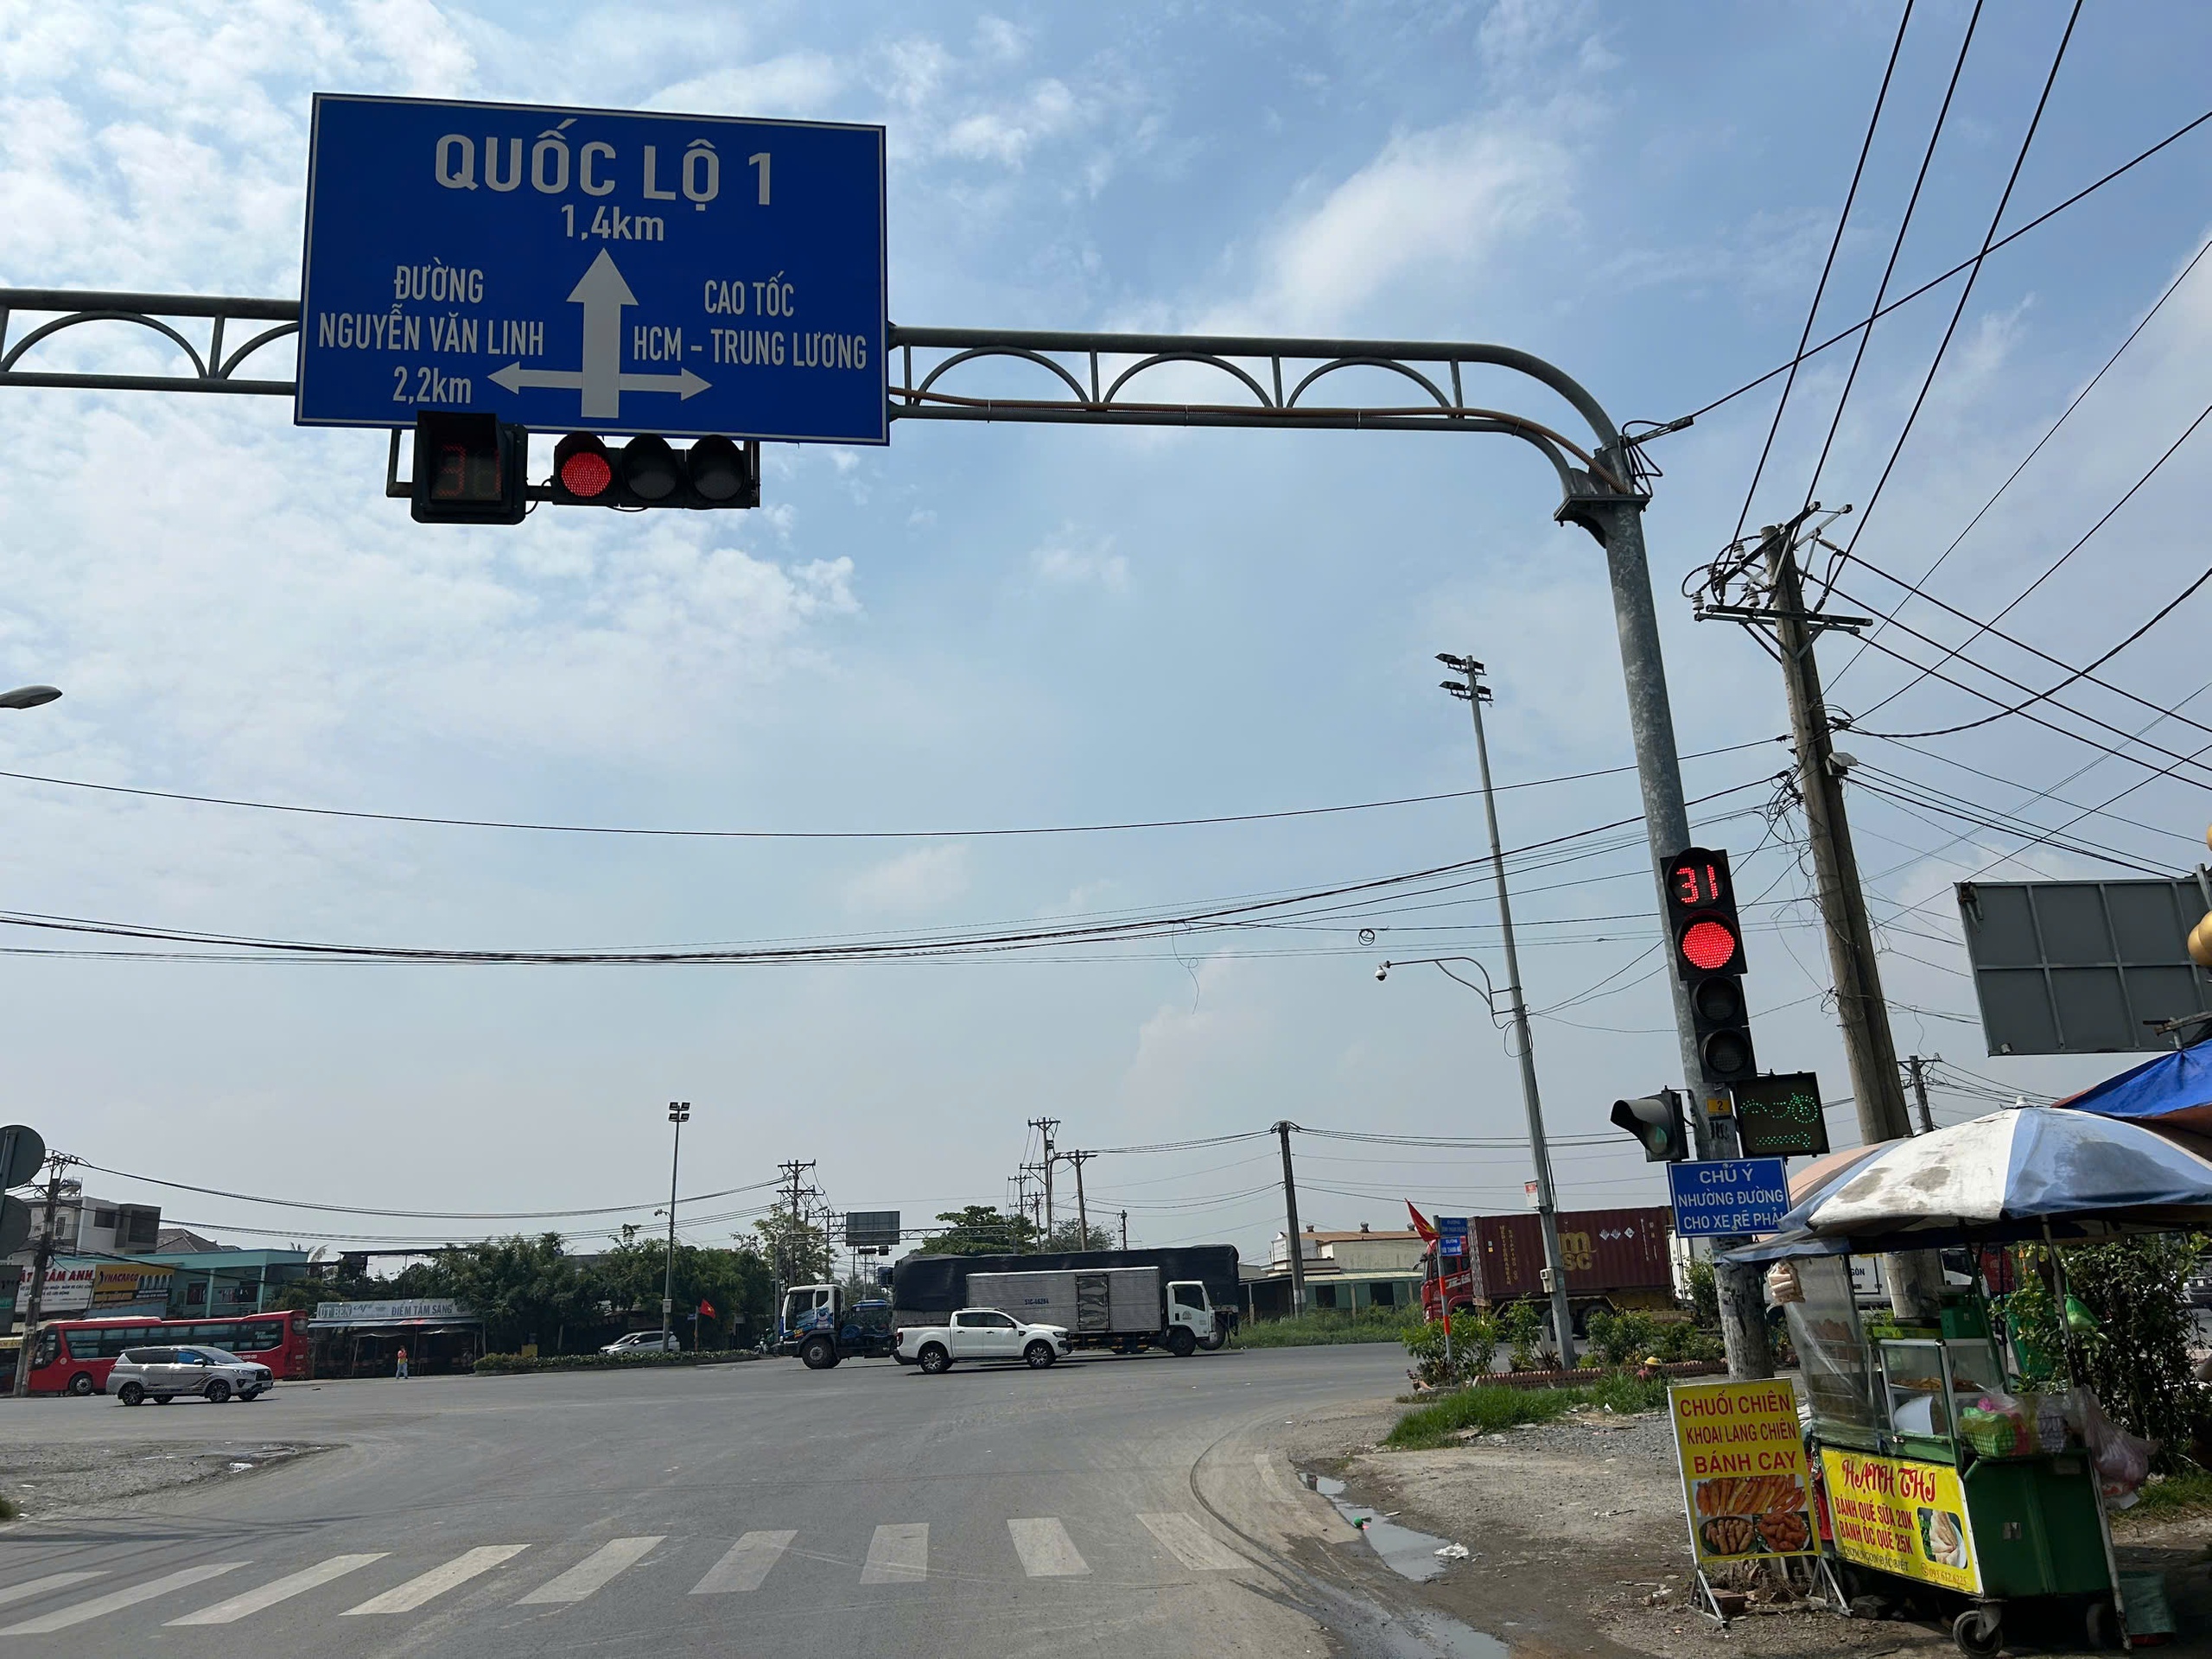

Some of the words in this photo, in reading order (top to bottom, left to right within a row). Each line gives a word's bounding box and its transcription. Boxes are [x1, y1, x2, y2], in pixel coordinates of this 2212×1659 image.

[435, 118, 616, 195] QUỐC
[643, 139, 719, 211] LỘ
[748, 153, 772, 205] 1
[561, 205, 664, 241] 1,4km
[393, 257, 484, 303] ĐƯỜNG
[704, 279, 745, 315] CAO
[752, 270, 794, 317] TỐC
[319, 304, 421, 351] NGUYỄN
[429, 315, 480, 354] VĂN
[487, 321, 544, 356] LINH
[633, 325, 682, 362] HCM
[710, 327, 785, 366] TRUNG
[791, 331, 868, 370] LƯƠNG
[392, 366, 473, 405] 2,2km
[1676, 864, 1719, 904] 31
[1717, 1100, 1724, 1111] 2
[1741, 1163, 1754, 1182] Ý
[1678, 1188, 1734, 1207] NHƯỜNG
[1737, 1185, 1783, 1205] ĐƯỜNG
[1683, 1215, 1710, 1230] CHO
[1713, 1214, 1731, 1228] XE
[1680, 1389, 1733, 1417] CHUỐI
[1738, 1390, 1791, 1414] CHIÊN
[1686, 1425, 1723, 1445] KHOAI
[1725, 1423, 1758, 1443] LANG
[1760, 1418, 1796, 1441] CHIÊN
[1694, 1450, 1751, 1474] BÁNH
[1758, 1451, 1796, 1471] CAY
[1842, 1459, 1896, 1498] HẠNH
[1834, 1494, 1858, 1520] BÁNH
[1859, 1498, 1877, 1523] QUẾ
[1877, 1503, 1897, 1527] SỮA
[1896, 1510, 1916, 1531] 20K
[1840, 1519, 1863, 1543] BÁNH
[1877, 1527, 1895, 1551] QUẾ
[1895, 1534, 1915, 1554] 25K
